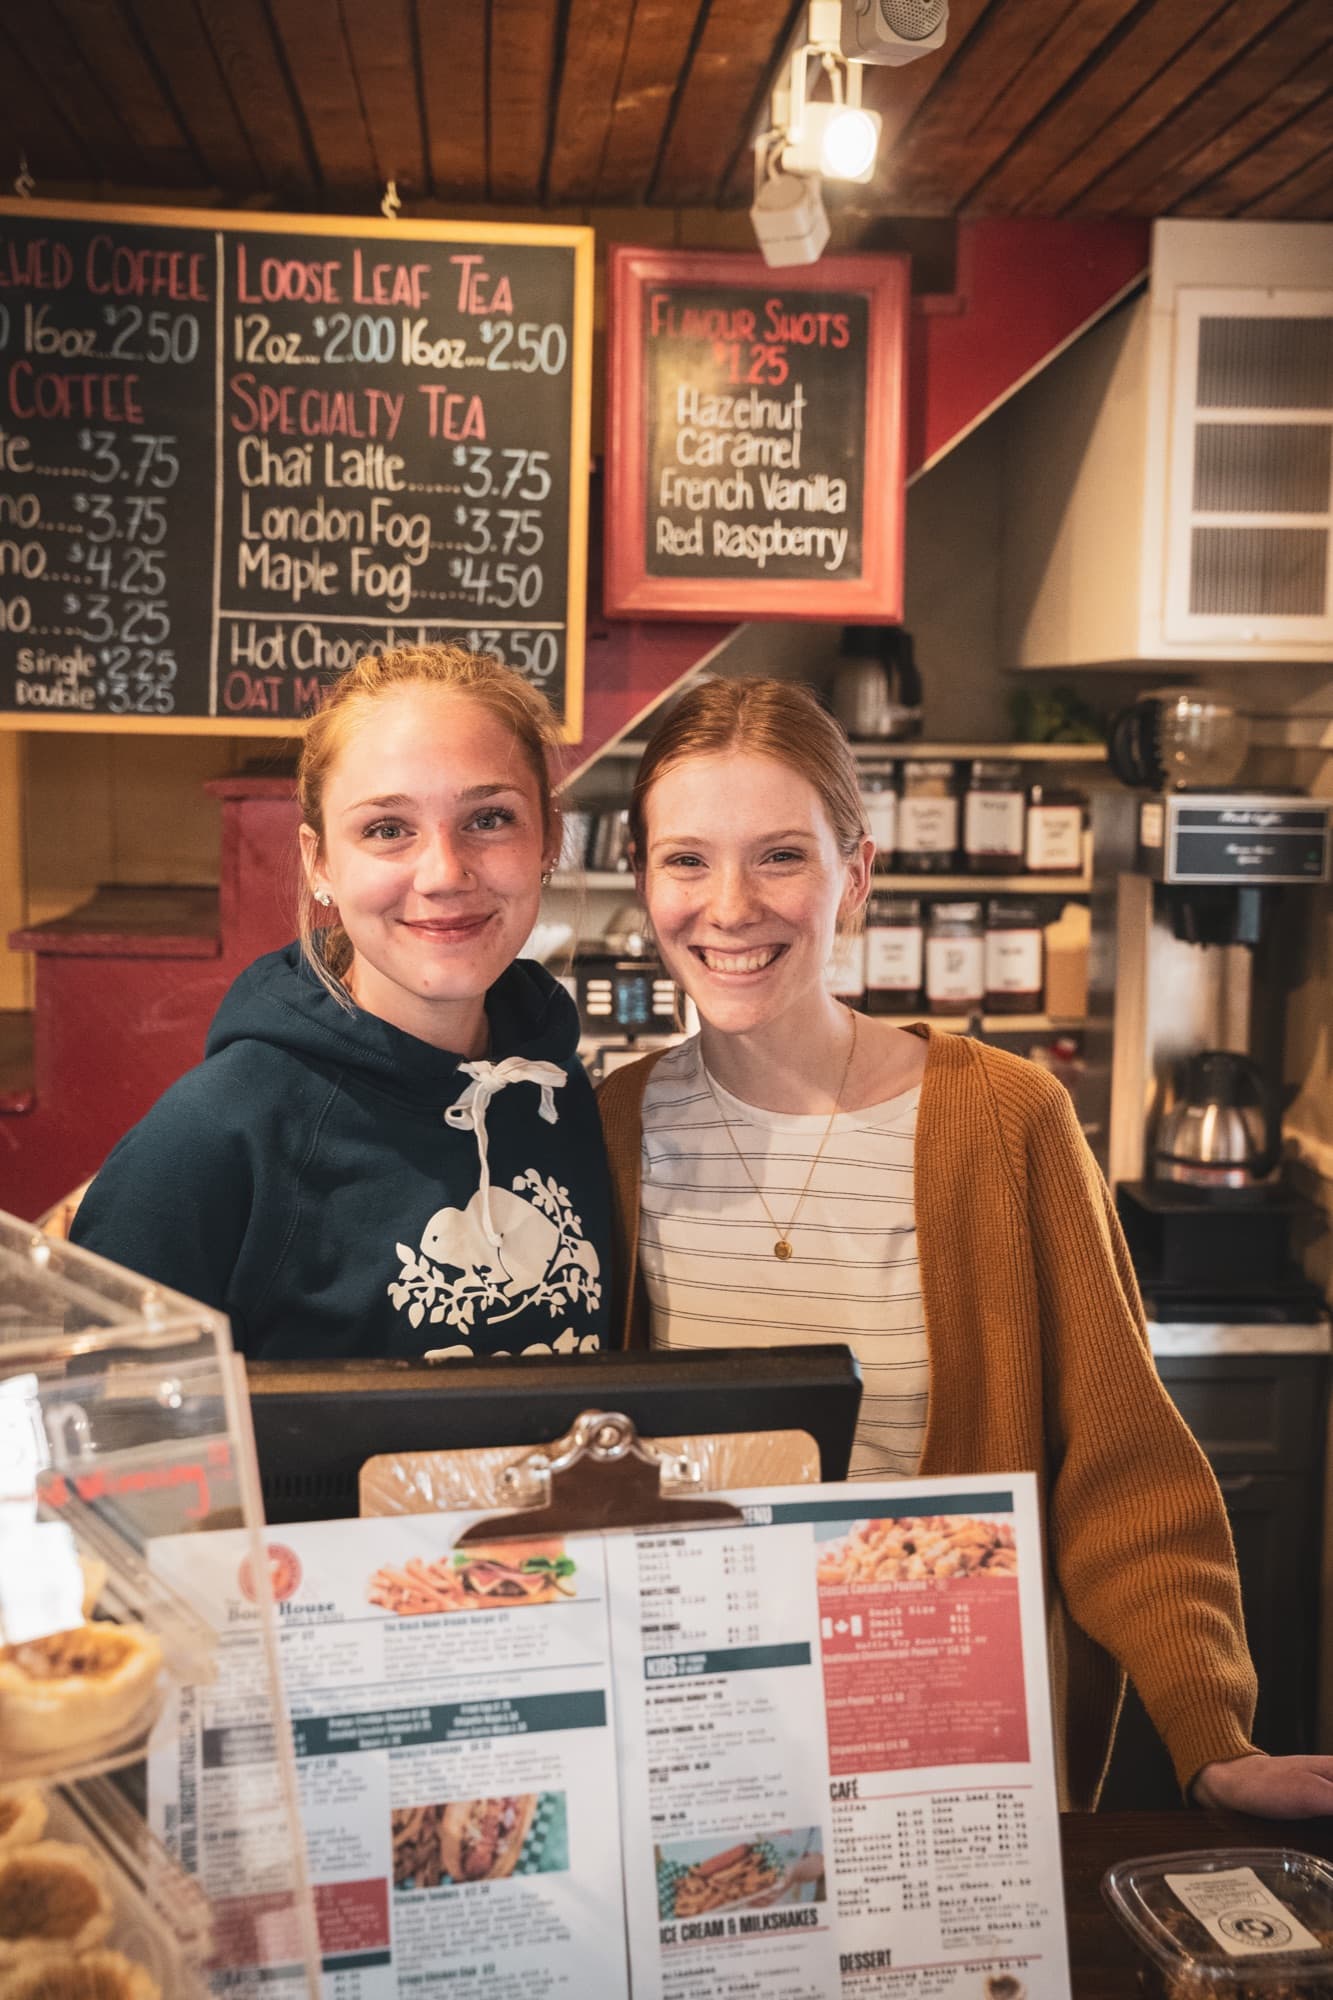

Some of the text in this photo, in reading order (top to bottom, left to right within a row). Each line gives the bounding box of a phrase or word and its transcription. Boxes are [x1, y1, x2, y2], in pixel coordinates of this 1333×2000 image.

[0, 235, 208, 300] WED COFFEE
[237, 242, 514, 316] LOOSE LEAF TEA
[651, 294, 849, 348] FLAVOUR SHOTS
[8, 360, 145, 424] COFFEE
[229, 372, 487, 442] SPECIALTY TEA
[677, 384, 807, 430] Hazelnut
[78, 428, 180, 488] $3.75
[238, 434, 551, 501] Chai Latte $3.75
[676, 428, 800, 470] Caramel
[660, 467, 847, 515] French Vanilla
[73, 493, 168, 545] $3.75
[241, 489, 545, 566] London Fog $3.75
[656, 515, 848, 571] Red Raspberry
[66, 542, 167, 595] $4.25
[238, 541, 340, 602] Maple
[351, 547, 412, 613] Fog
[64, 594, 171, 645] $3.25
[230, 622, 287, 670] Hot
[224, 671, 284, 711] OAT
[660, 1924, 677, 1944] ICE
[681, 1919, 724, 1941] CREAM
[740, 1908, 818, 1934] MILKSHAKES
[840, 1949, 892, 1972] DESSERT
